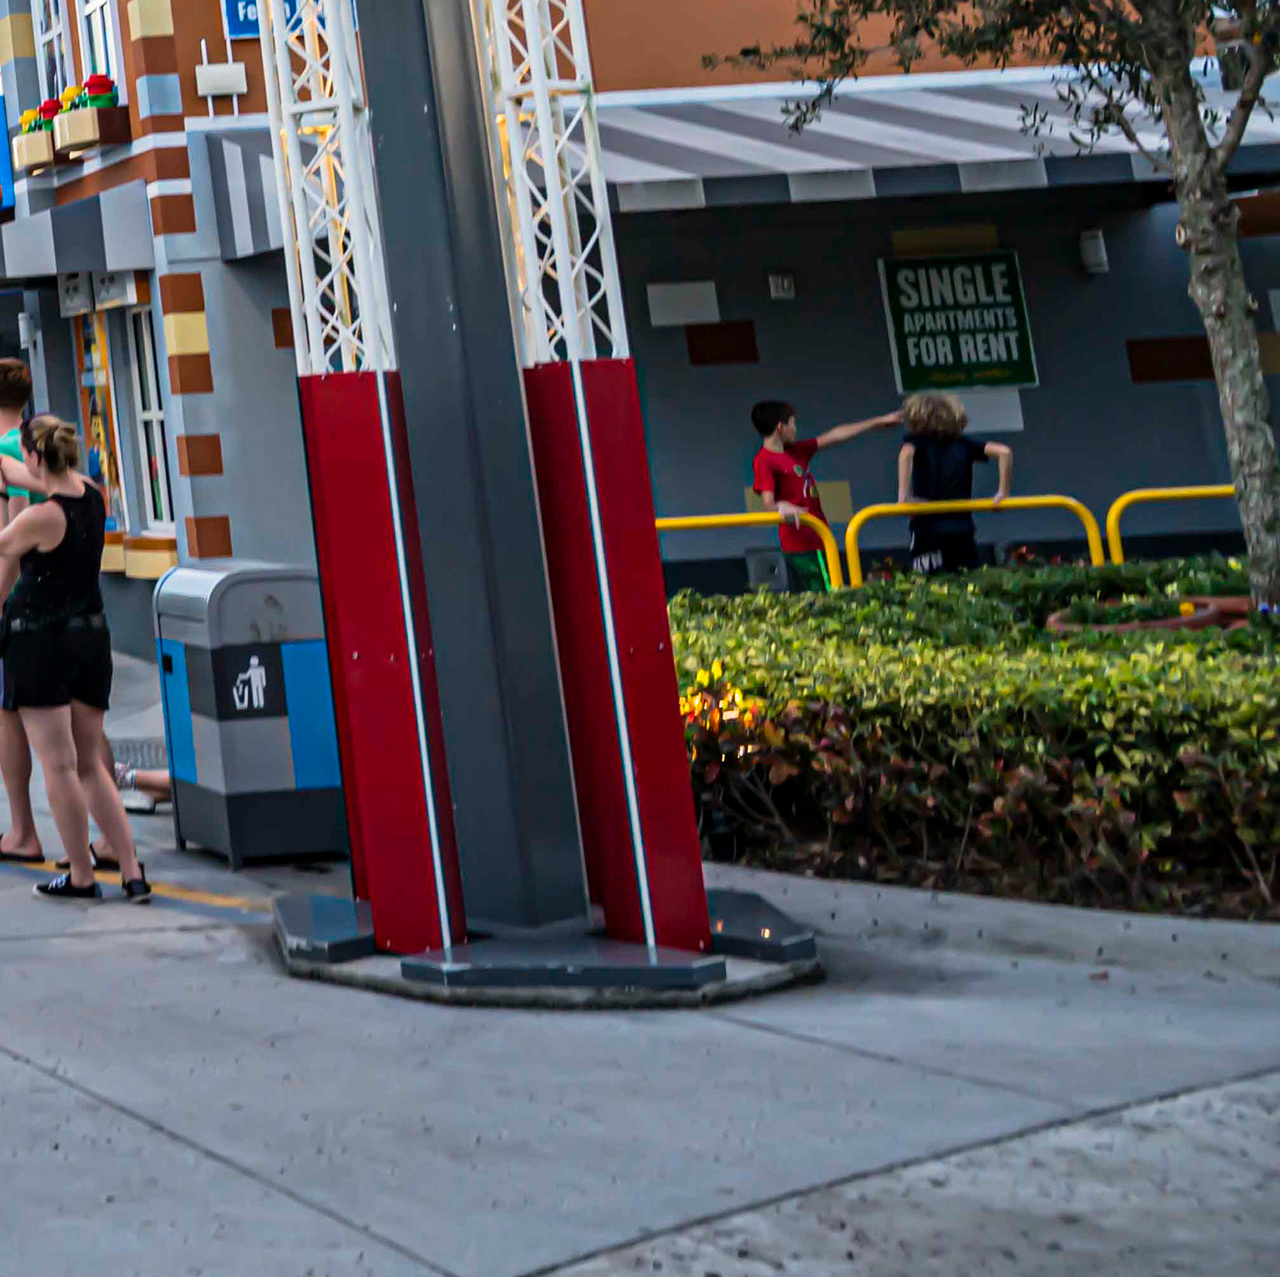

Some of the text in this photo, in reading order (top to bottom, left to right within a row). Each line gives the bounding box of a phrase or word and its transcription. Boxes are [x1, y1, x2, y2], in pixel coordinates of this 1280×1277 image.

[896, 263, 1012, 309] SINGLE
[903, 306, 1018, 335] APARTMENTS
[906, 330, 1019, 368] FOR RENT
